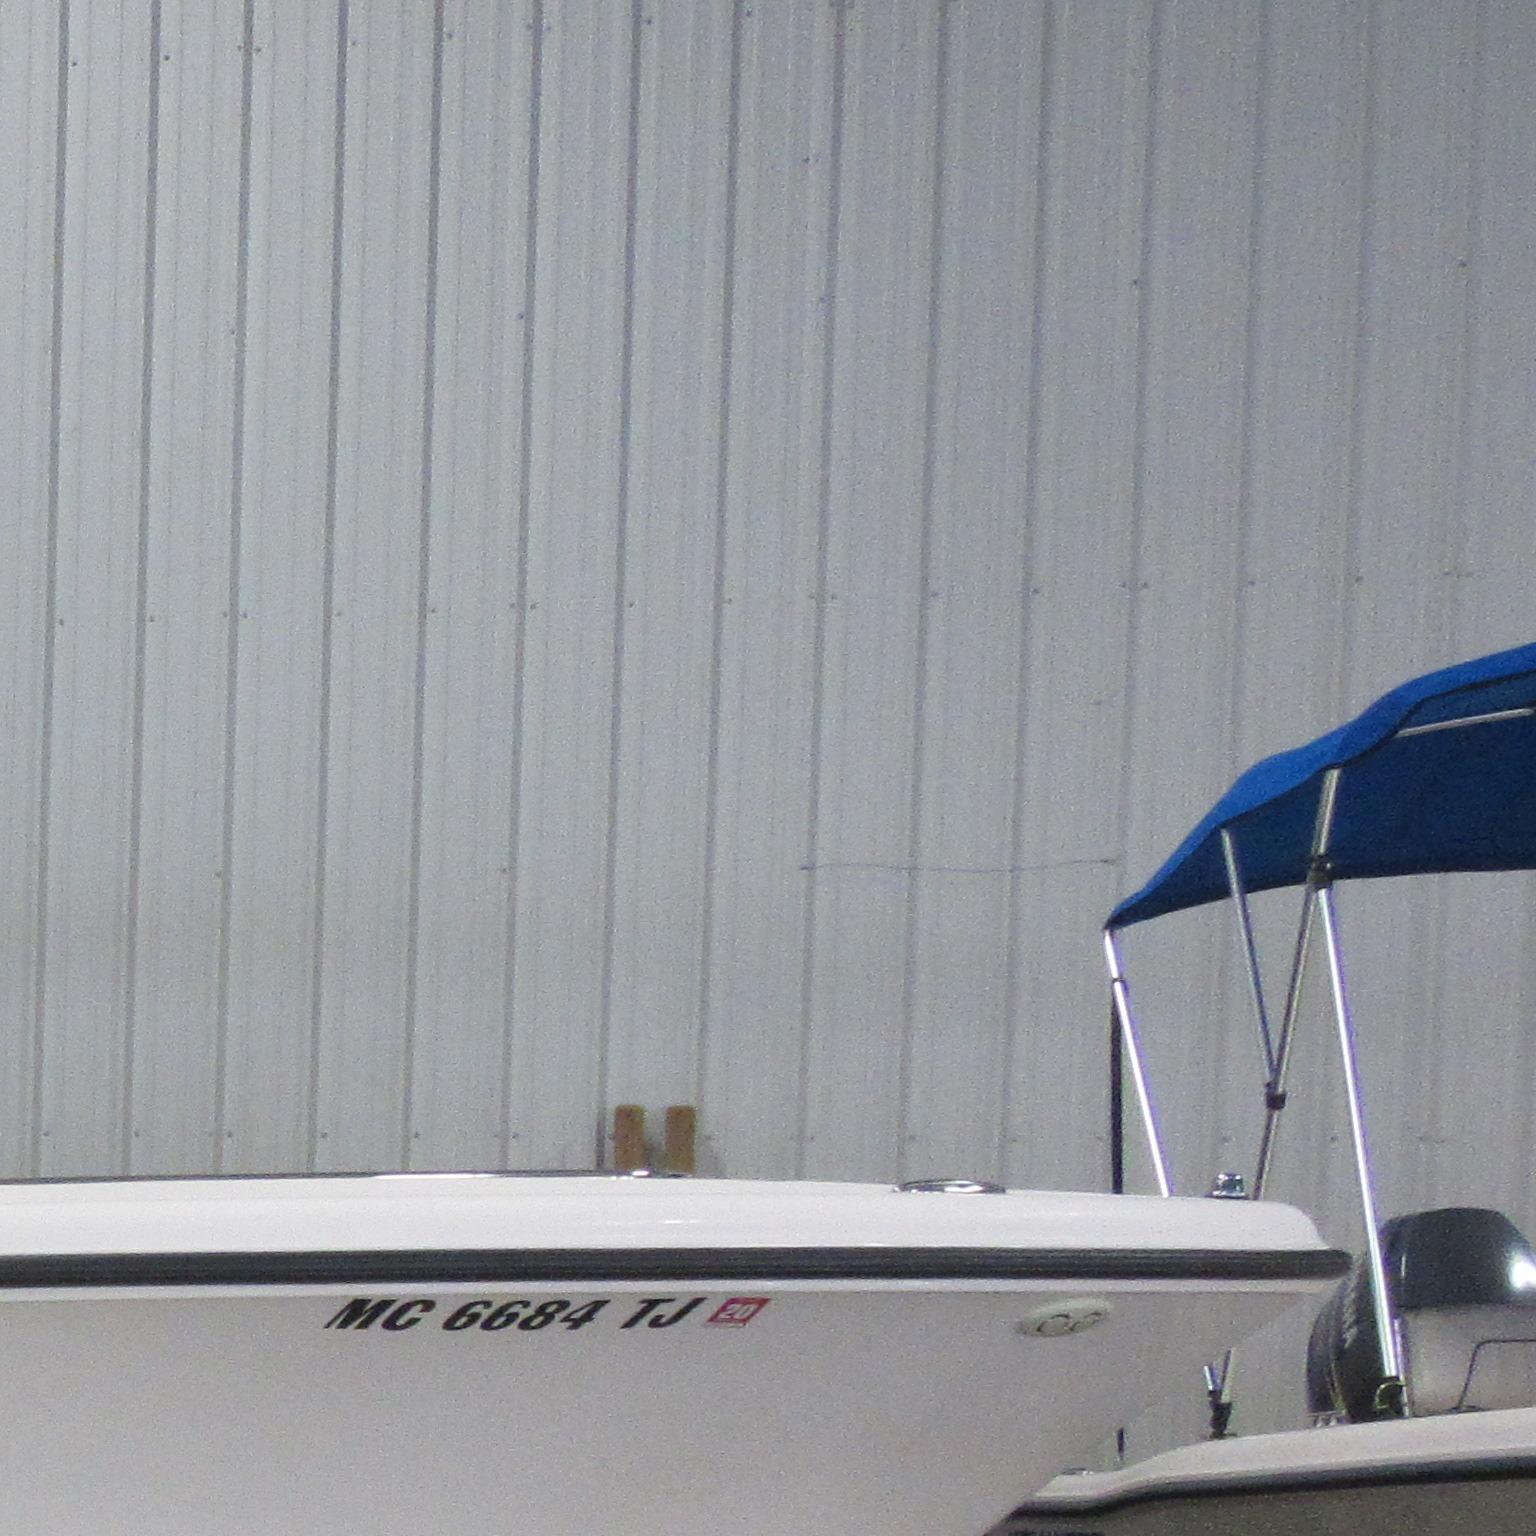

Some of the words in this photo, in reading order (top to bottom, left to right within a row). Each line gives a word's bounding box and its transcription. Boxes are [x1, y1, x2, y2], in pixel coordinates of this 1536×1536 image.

[323, 1298, 436, 1331] MC
[442, 1299, 611, 1331] 6684
[619, 1296, 708, 1330] TJ
